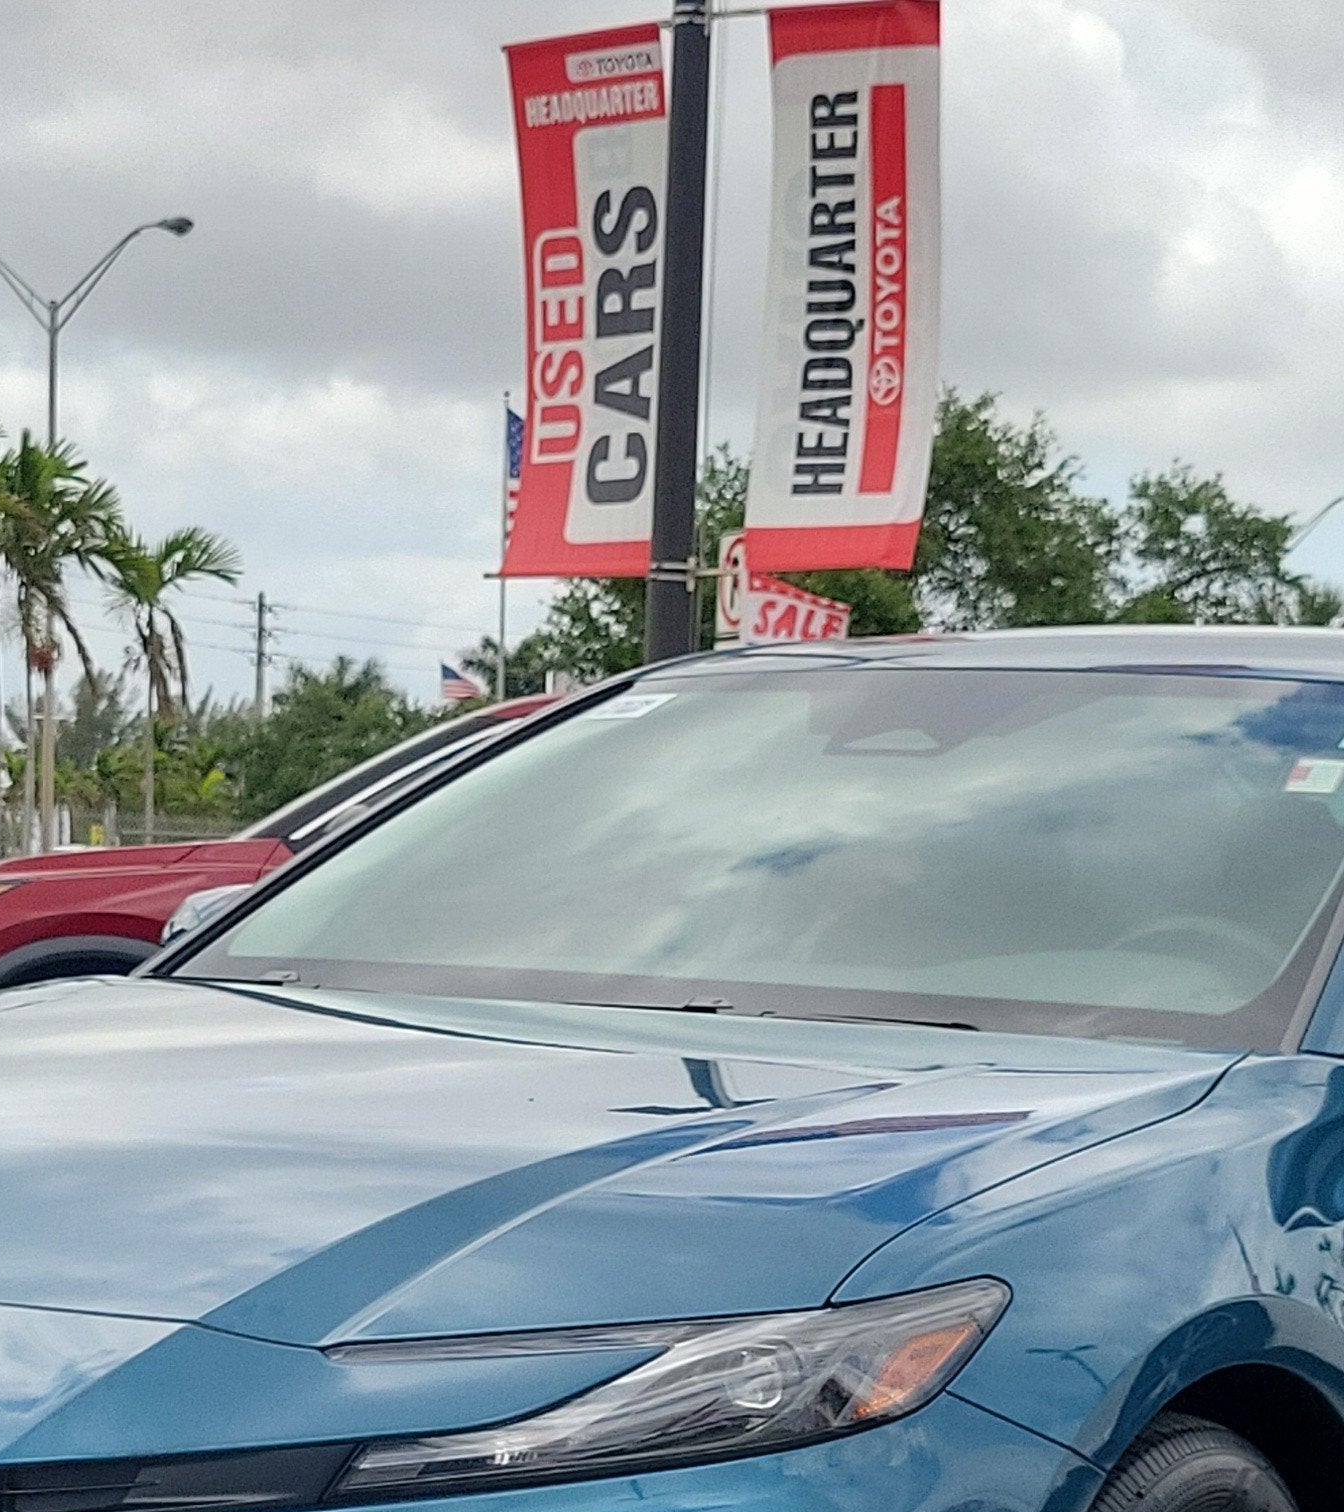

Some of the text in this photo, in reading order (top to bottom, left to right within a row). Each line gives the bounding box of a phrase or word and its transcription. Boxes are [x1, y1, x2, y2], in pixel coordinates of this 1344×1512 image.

[525, 78, 659, 128] HEADQUARTER
[596, 51, 654, 75] TOYOTA
[535, 232, 585, 460] USED
[587, 186, 658, 504] CARS
[791, 91, 866, 495] HEADQUARTER
[873, 195, 903, 355] TOYOTA
[753, 600, 844, 641] SALE
